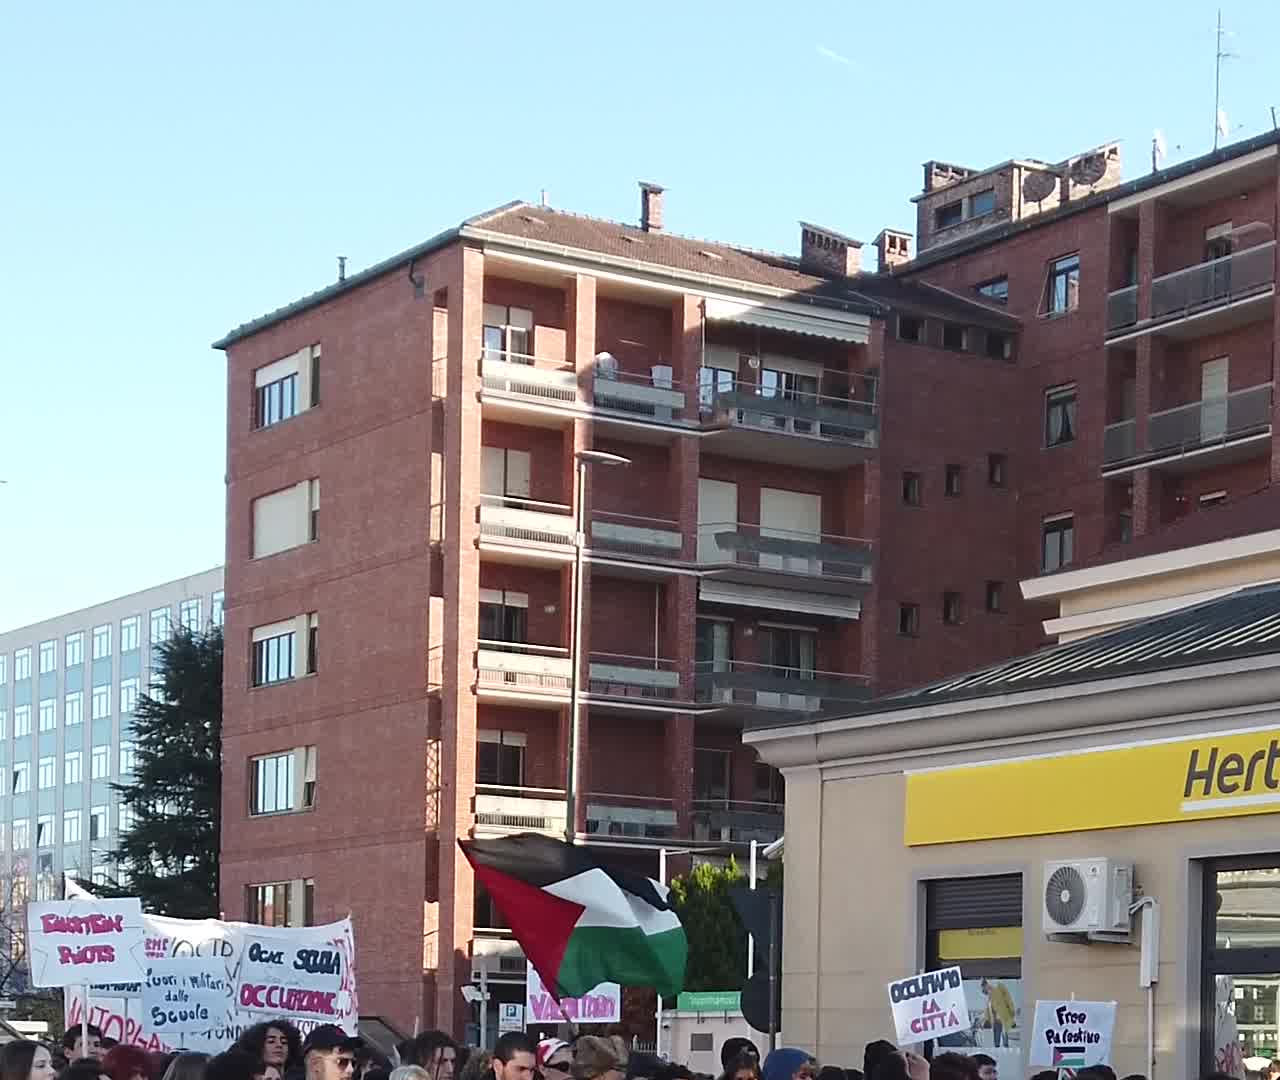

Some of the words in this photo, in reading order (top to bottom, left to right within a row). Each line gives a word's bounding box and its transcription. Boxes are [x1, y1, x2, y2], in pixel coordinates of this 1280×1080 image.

[890, 969, 961, 1003] OCCUPIAMO
[922, 997, 941, 1014] LA
[1055, 1005, 1087, 1027] Free
